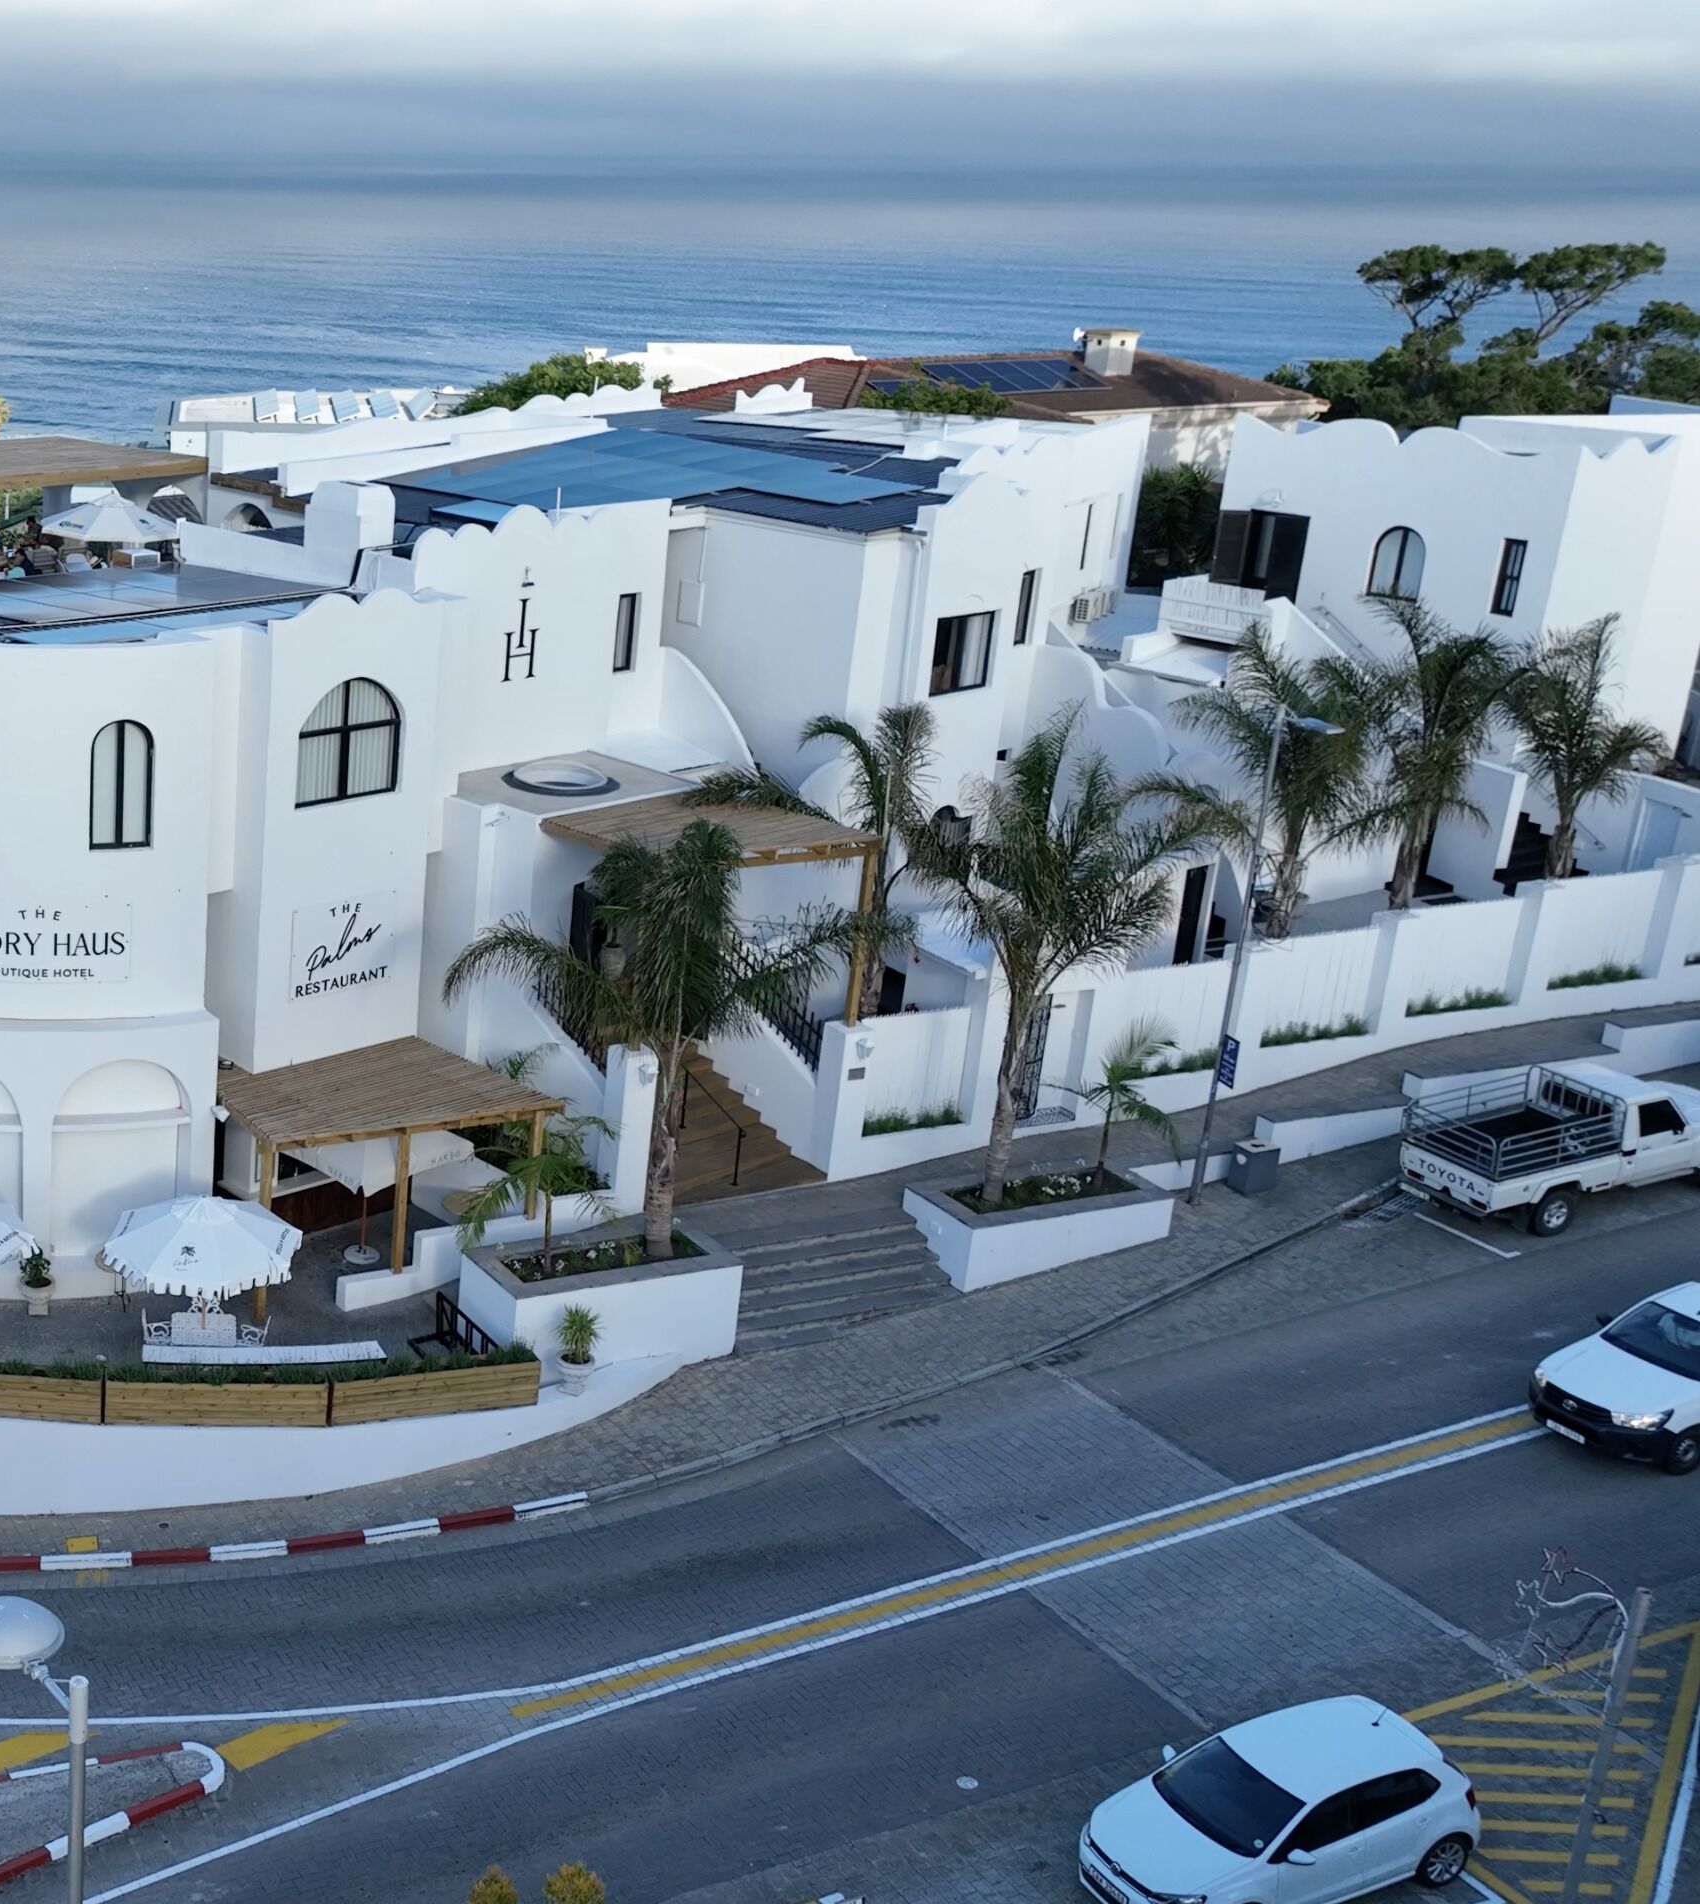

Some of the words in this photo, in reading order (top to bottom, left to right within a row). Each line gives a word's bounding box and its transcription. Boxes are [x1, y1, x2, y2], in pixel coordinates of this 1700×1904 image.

[17, 909, 62, 921] THE
[329, 902, 362, 917] THE
[52, 931, 126, 956] HAUS
[305, 912, 381, 981] Palms
[52, 968, 95, 978] HOTEL
[295, 965, 388, 998] RESTAURANT
[1418, 1158, 1475, 1193] TOYOTA
